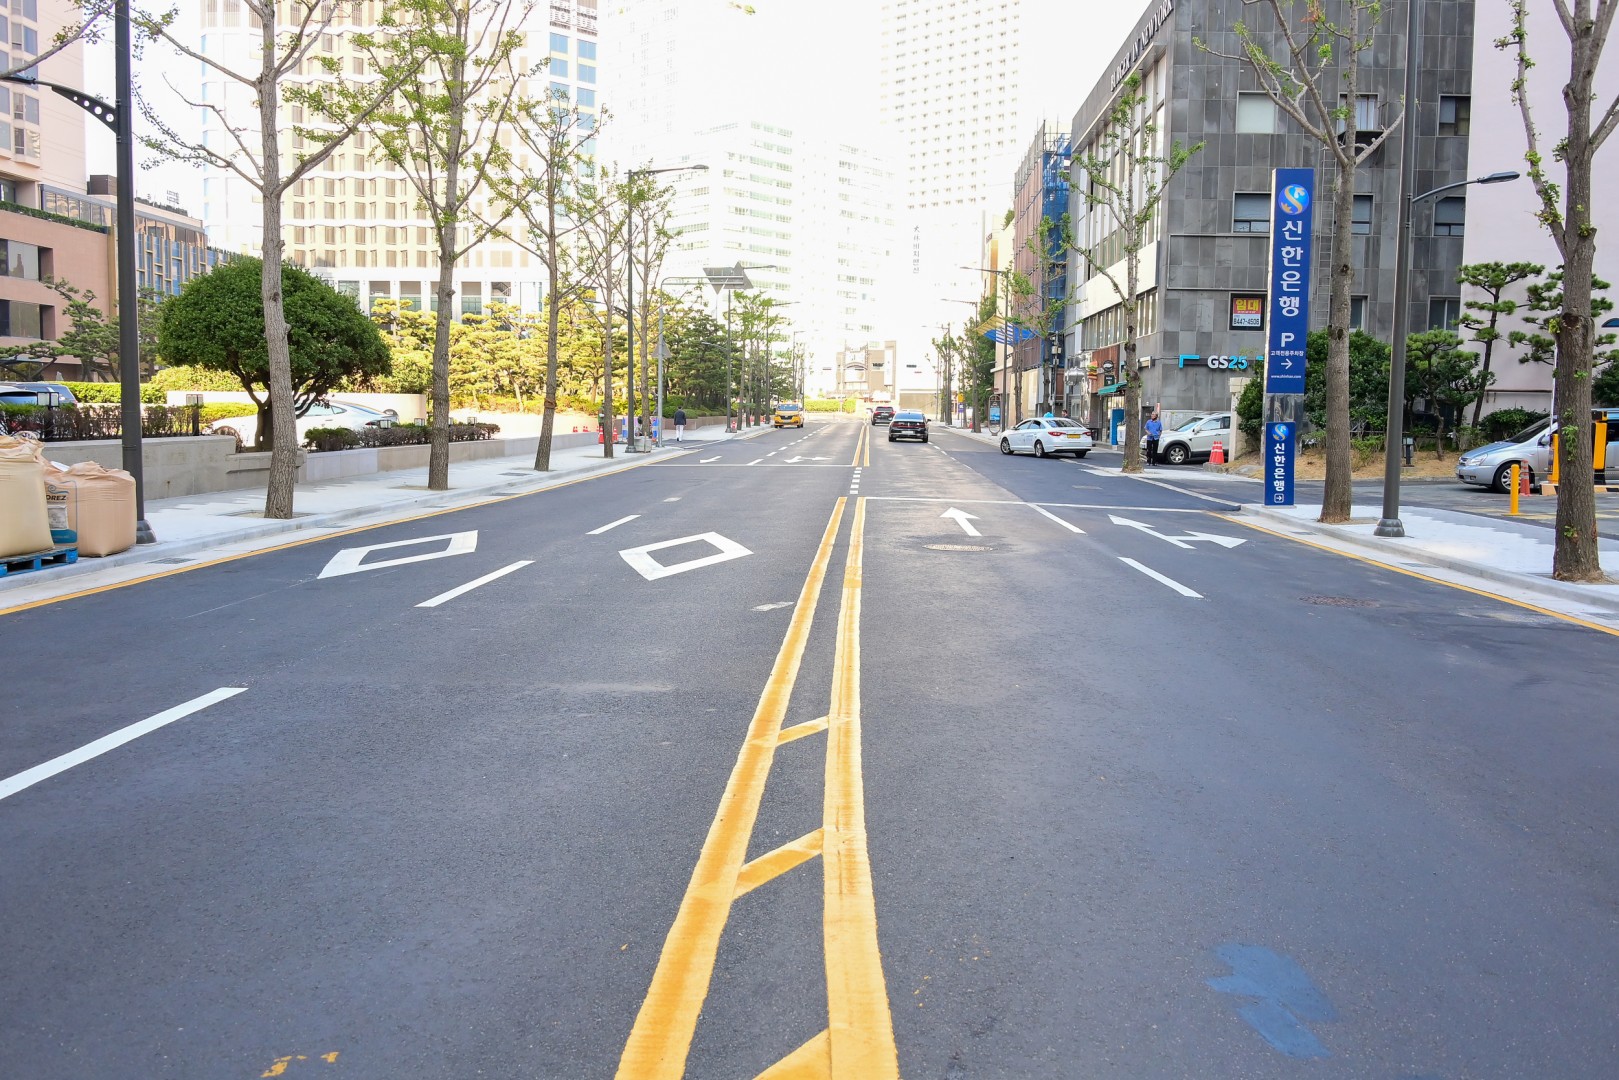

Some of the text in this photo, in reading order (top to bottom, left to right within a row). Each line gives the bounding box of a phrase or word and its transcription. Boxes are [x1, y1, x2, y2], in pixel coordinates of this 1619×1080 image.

[1278, 220, 1303, 317] 신한은행
[1236, 299, 1259, 311] 임대
[1281, 333, 1294, 347] P
[1207, 355, 1248, 369] GS25
[1273, 442, 1286, 492] 신한은행
